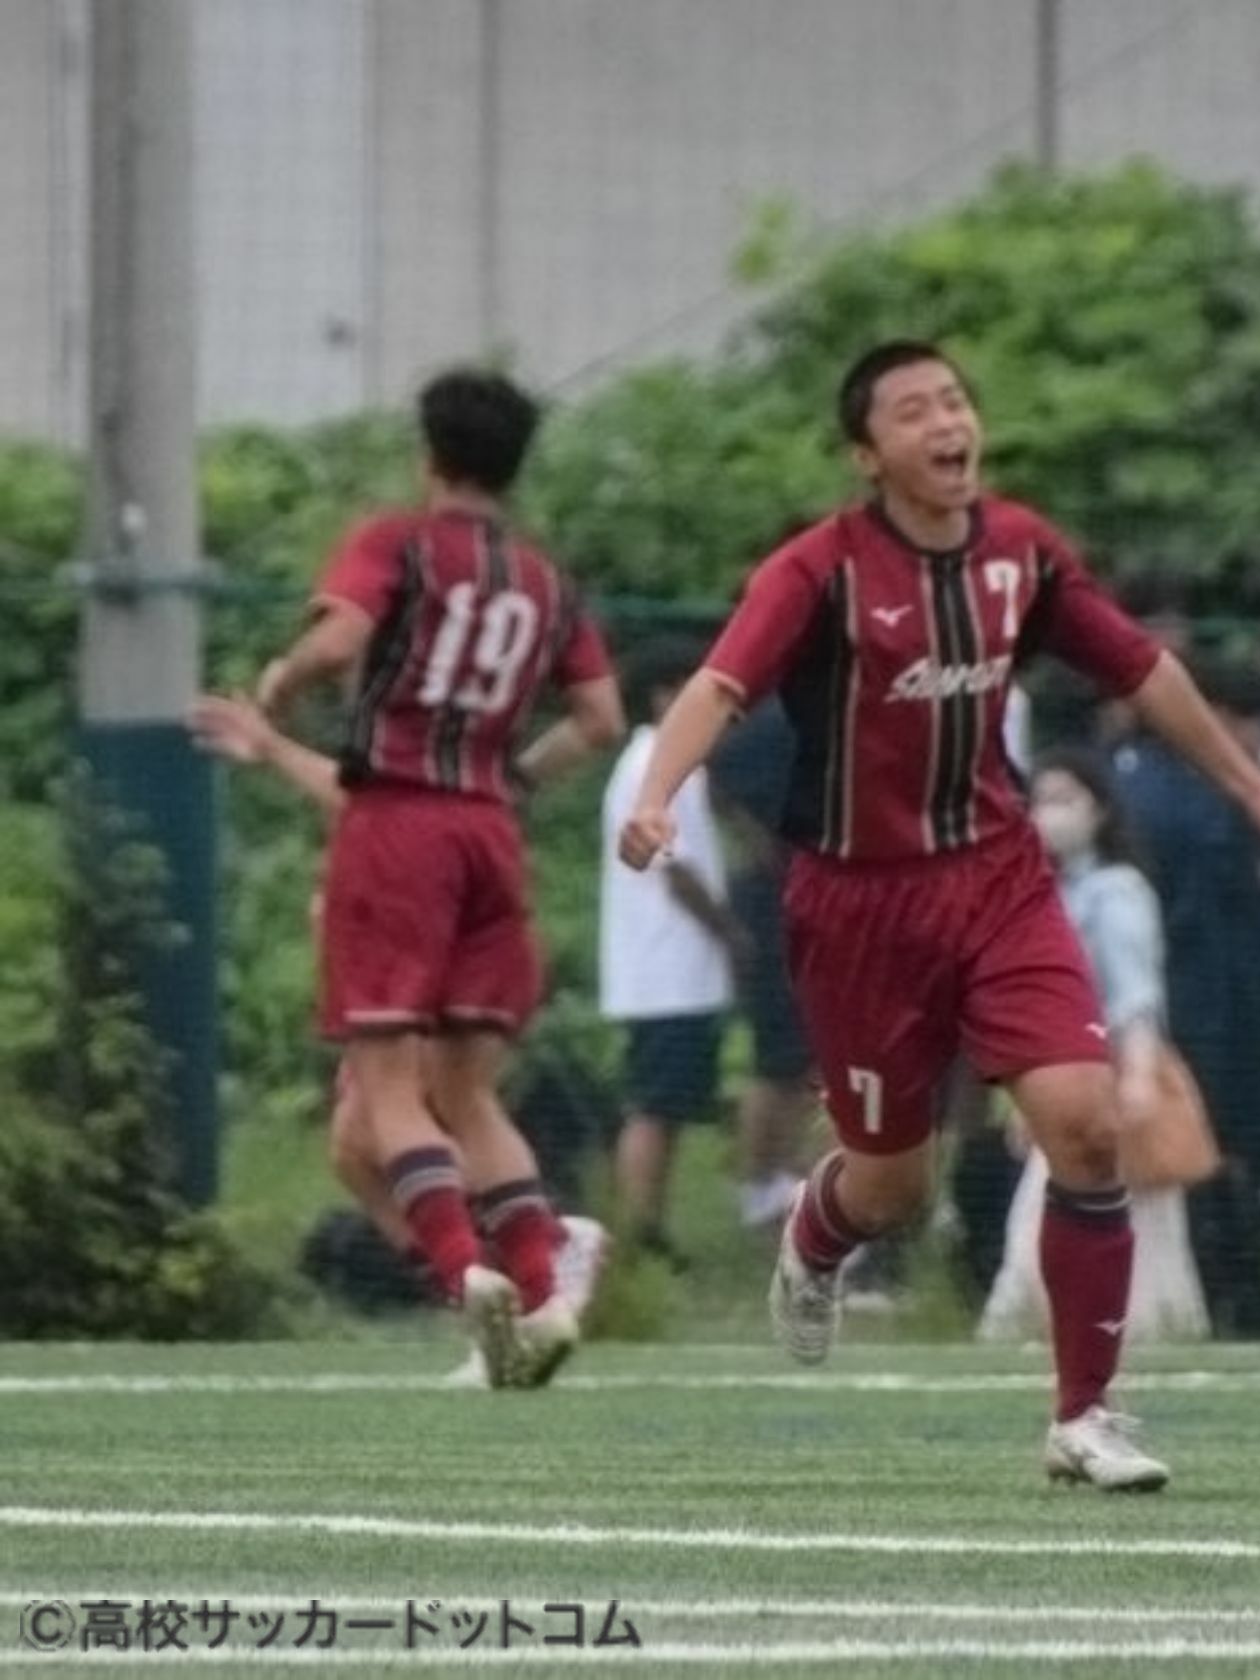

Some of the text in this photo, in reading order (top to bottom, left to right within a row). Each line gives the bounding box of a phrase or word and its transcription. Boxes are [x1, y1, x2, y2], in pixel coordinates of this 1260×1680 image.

[982, 560, 1020, 638] 7
[419, 582, 538, 713] 19
[848, 1067, 883, 1133] 7
